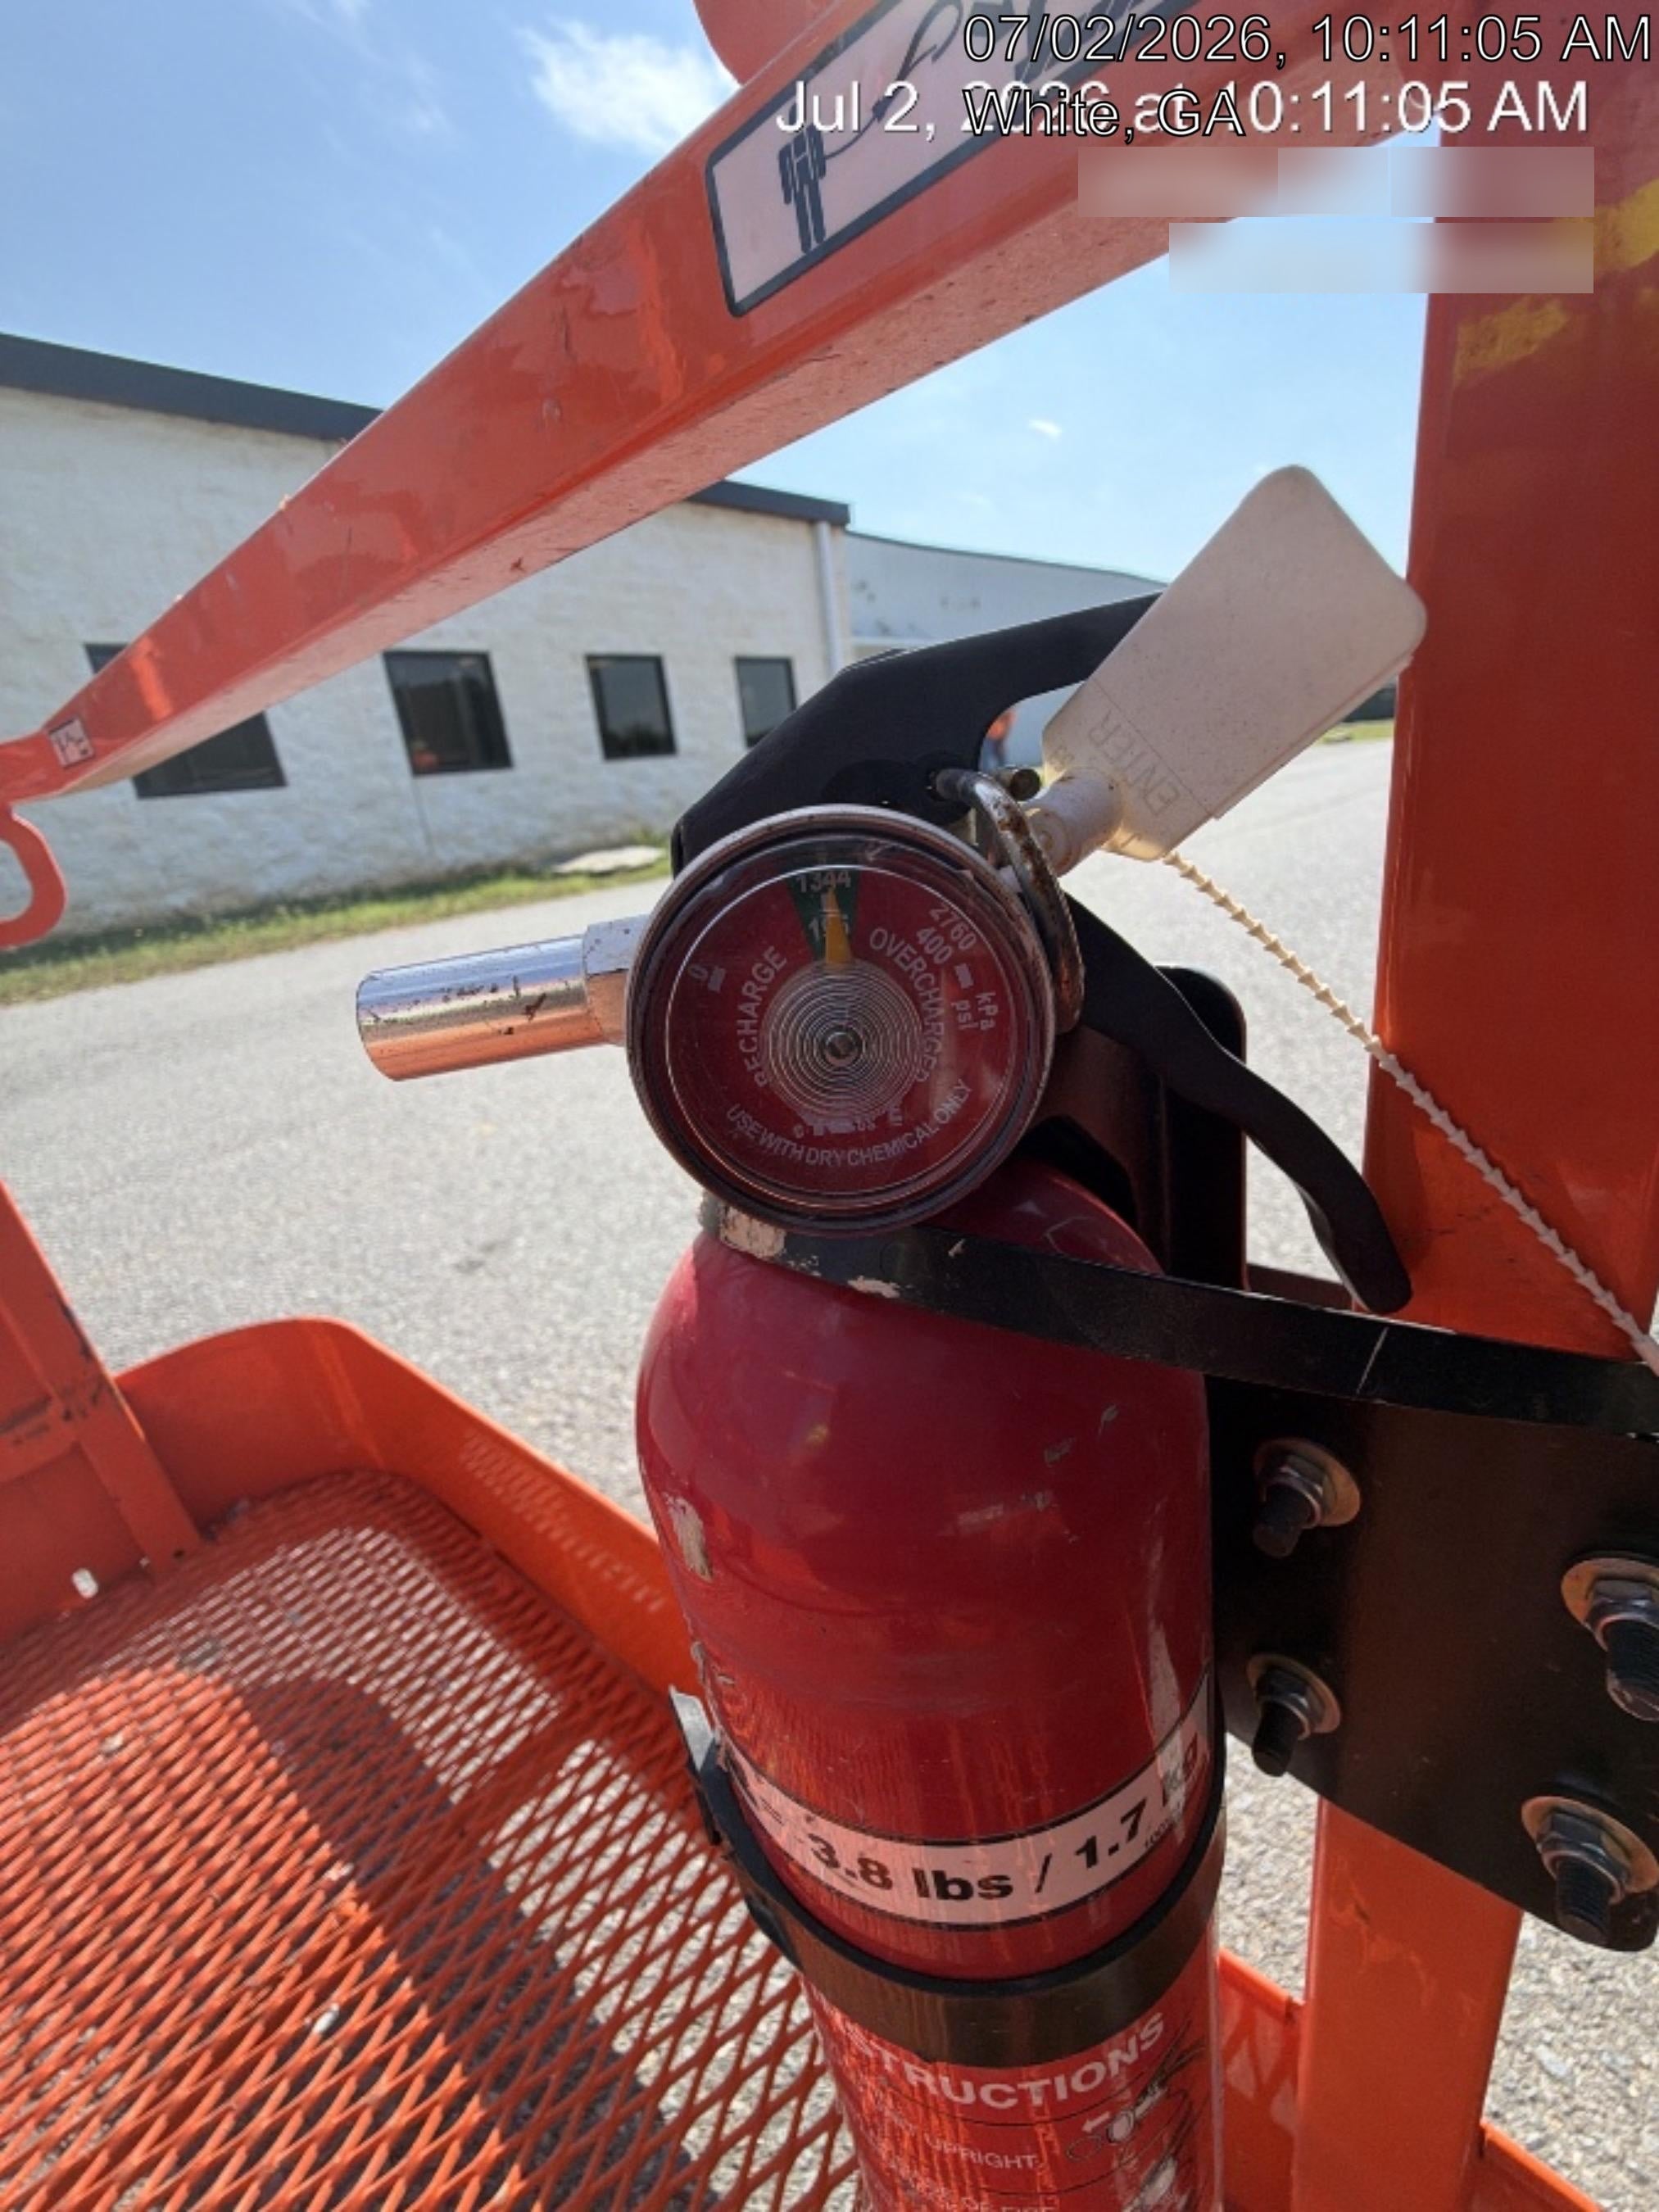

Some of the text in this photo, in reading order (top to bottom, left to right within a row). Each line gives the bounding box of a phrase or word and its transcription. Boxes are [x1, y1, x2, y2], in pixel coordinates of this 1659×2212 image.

[916, 927, 954, 964] 400
[928, 904, 977, 951] 2760
[726, 1104, 762, 1140] USE
[758, 1128, 803, 1162] WITH
[805, 1149, 843, 1167] DRY
[847, 1122, 941, 1167] CHEMICAL
[932, 1077, 972, 1124] ONLY
[808, 1833, 894, 1891] 3.8
[911, 1866, 1014, 1901] lbs
[1074, 1797, 1147, 1870] 1.7
